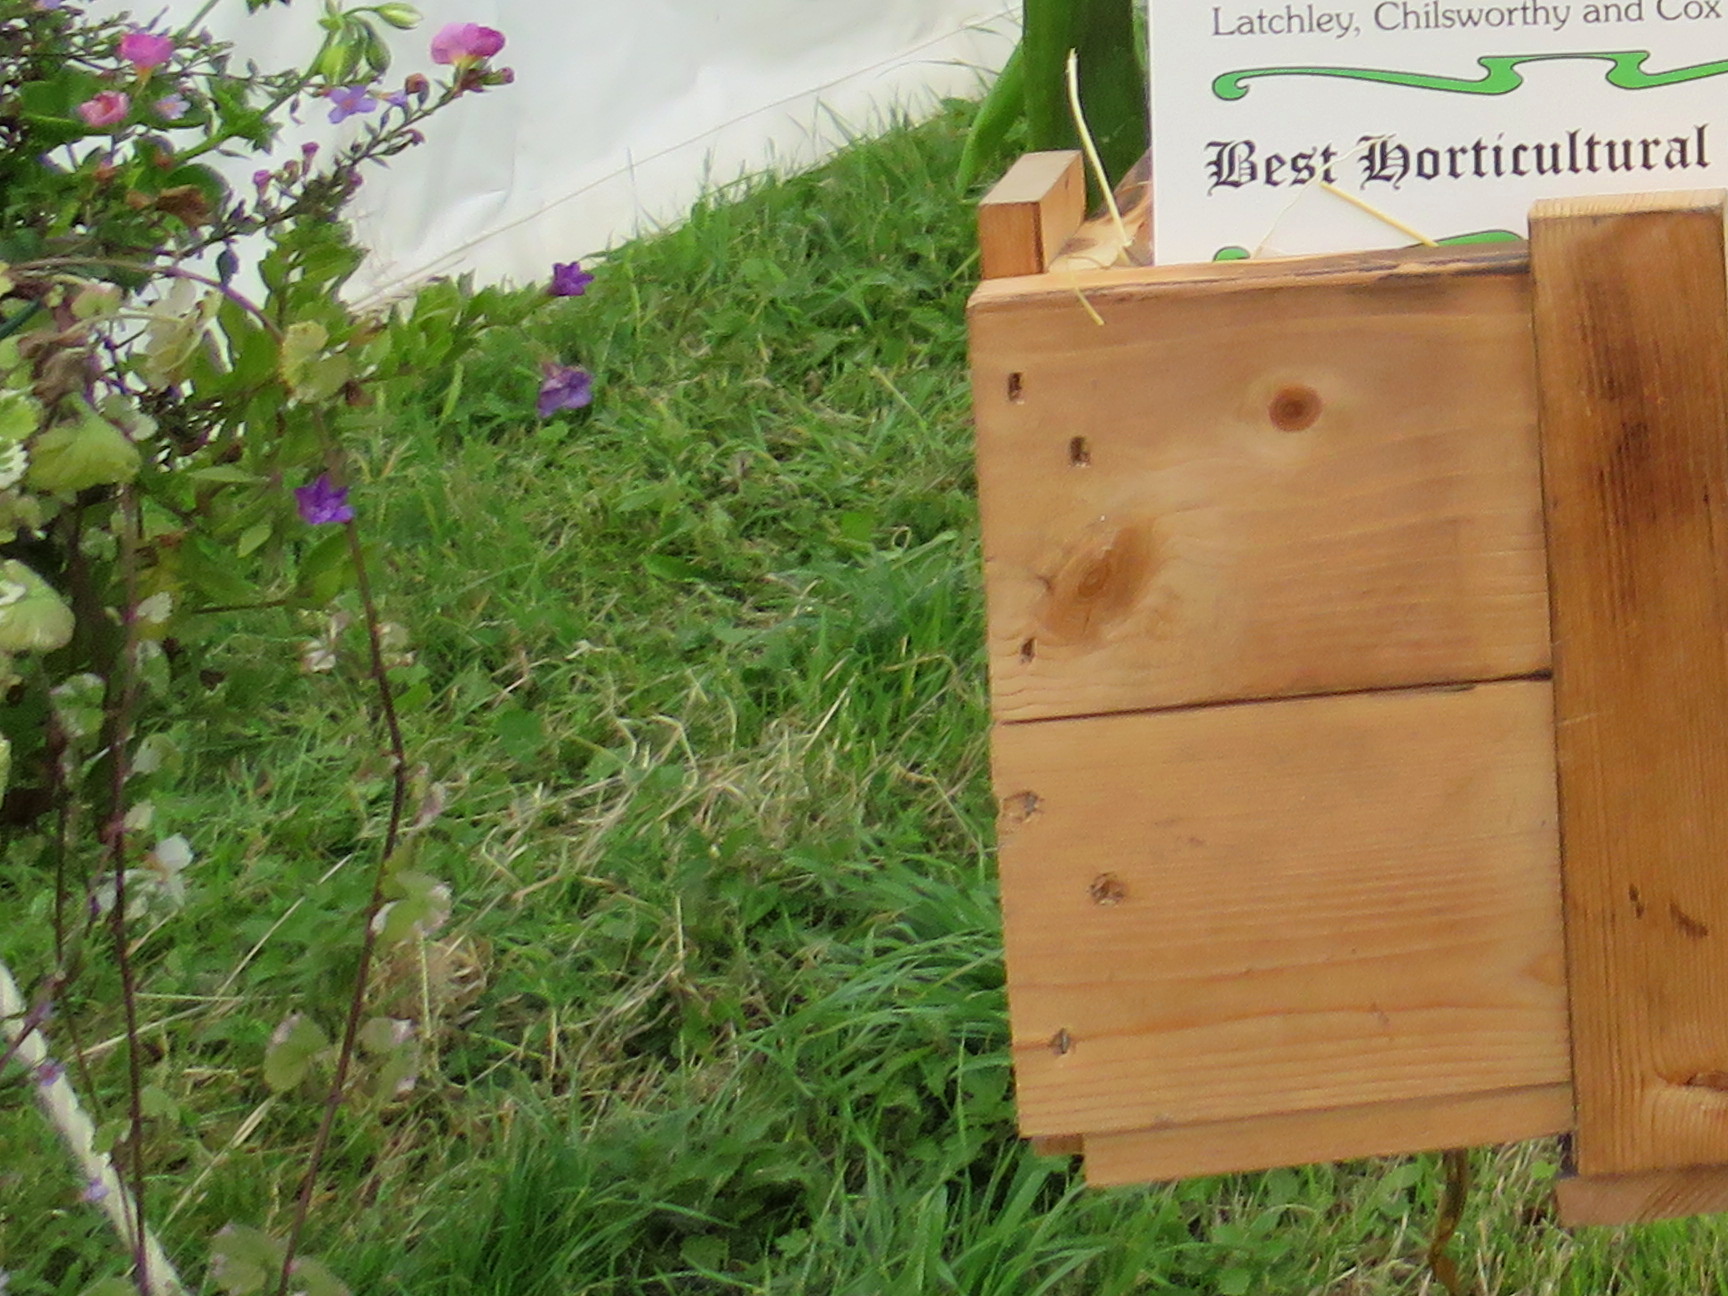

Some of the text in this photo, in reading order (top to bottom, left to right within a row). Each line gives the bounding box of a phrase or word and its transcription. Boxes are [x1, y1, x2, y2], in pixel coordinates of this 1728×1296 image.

[1214, 5, 1359, 38] Latchley,
[1206, 140, 1336, 194] Best
[1358, 125, 1708, 189] Horticultural
